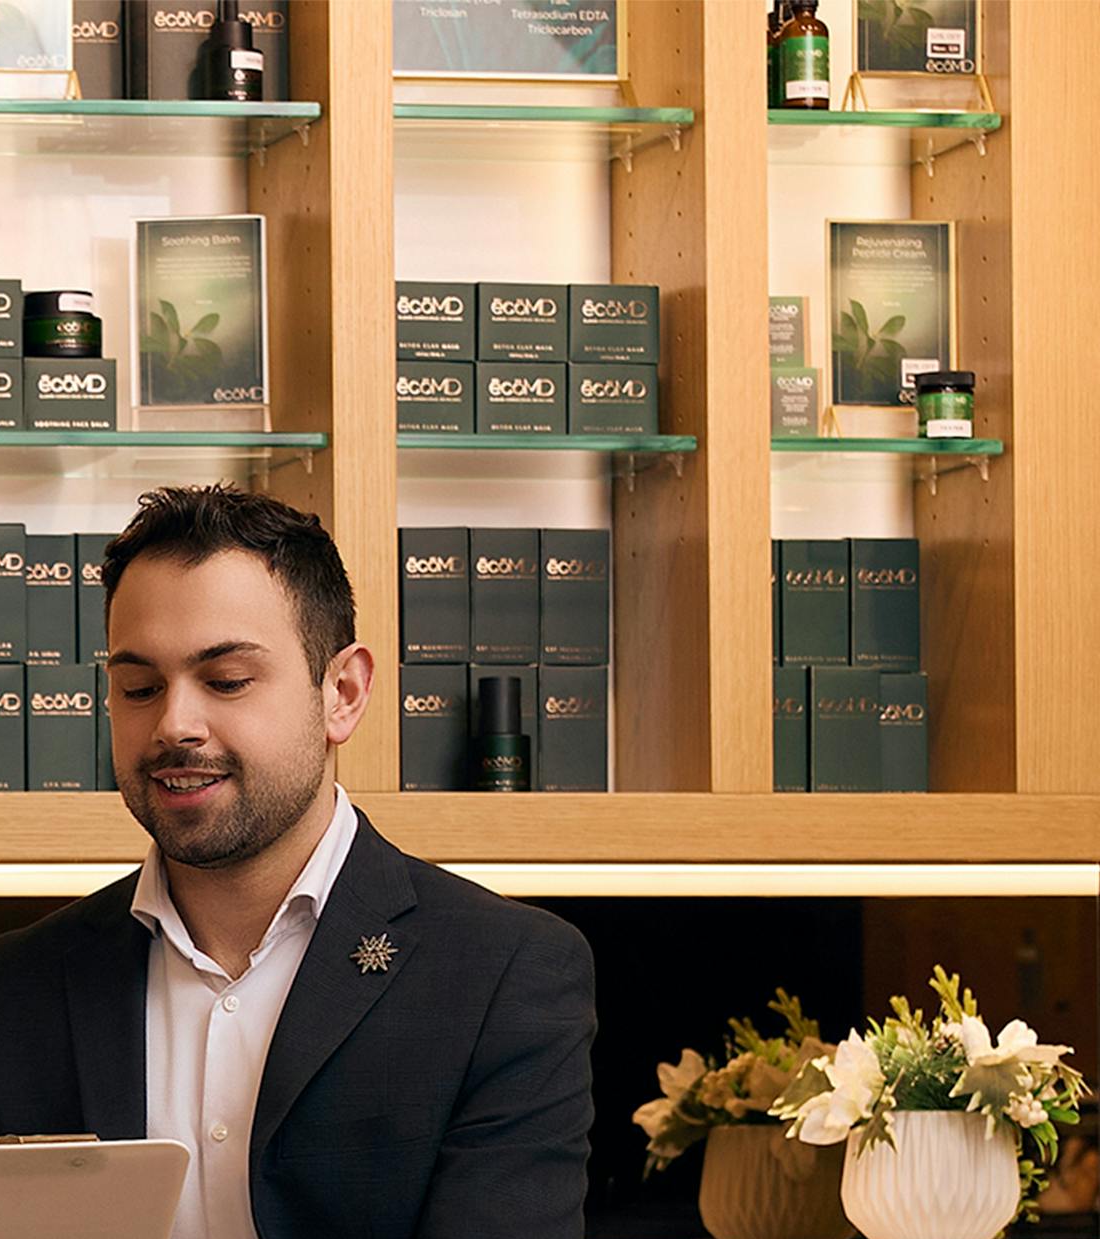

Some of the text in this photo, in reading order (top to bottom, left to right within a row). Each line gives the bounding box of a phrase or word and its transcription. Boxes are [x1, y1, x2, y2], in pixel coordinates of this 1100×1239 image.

[420, 7, 467, 17] Triclosan
[511, 9, 609, 21] Tetrasodium EDTA
[527, 24, 593, 35] Triclocarbon
[161, 235, 241, 247] Soothing Balm
[892, 249, 927, 258] Cream
